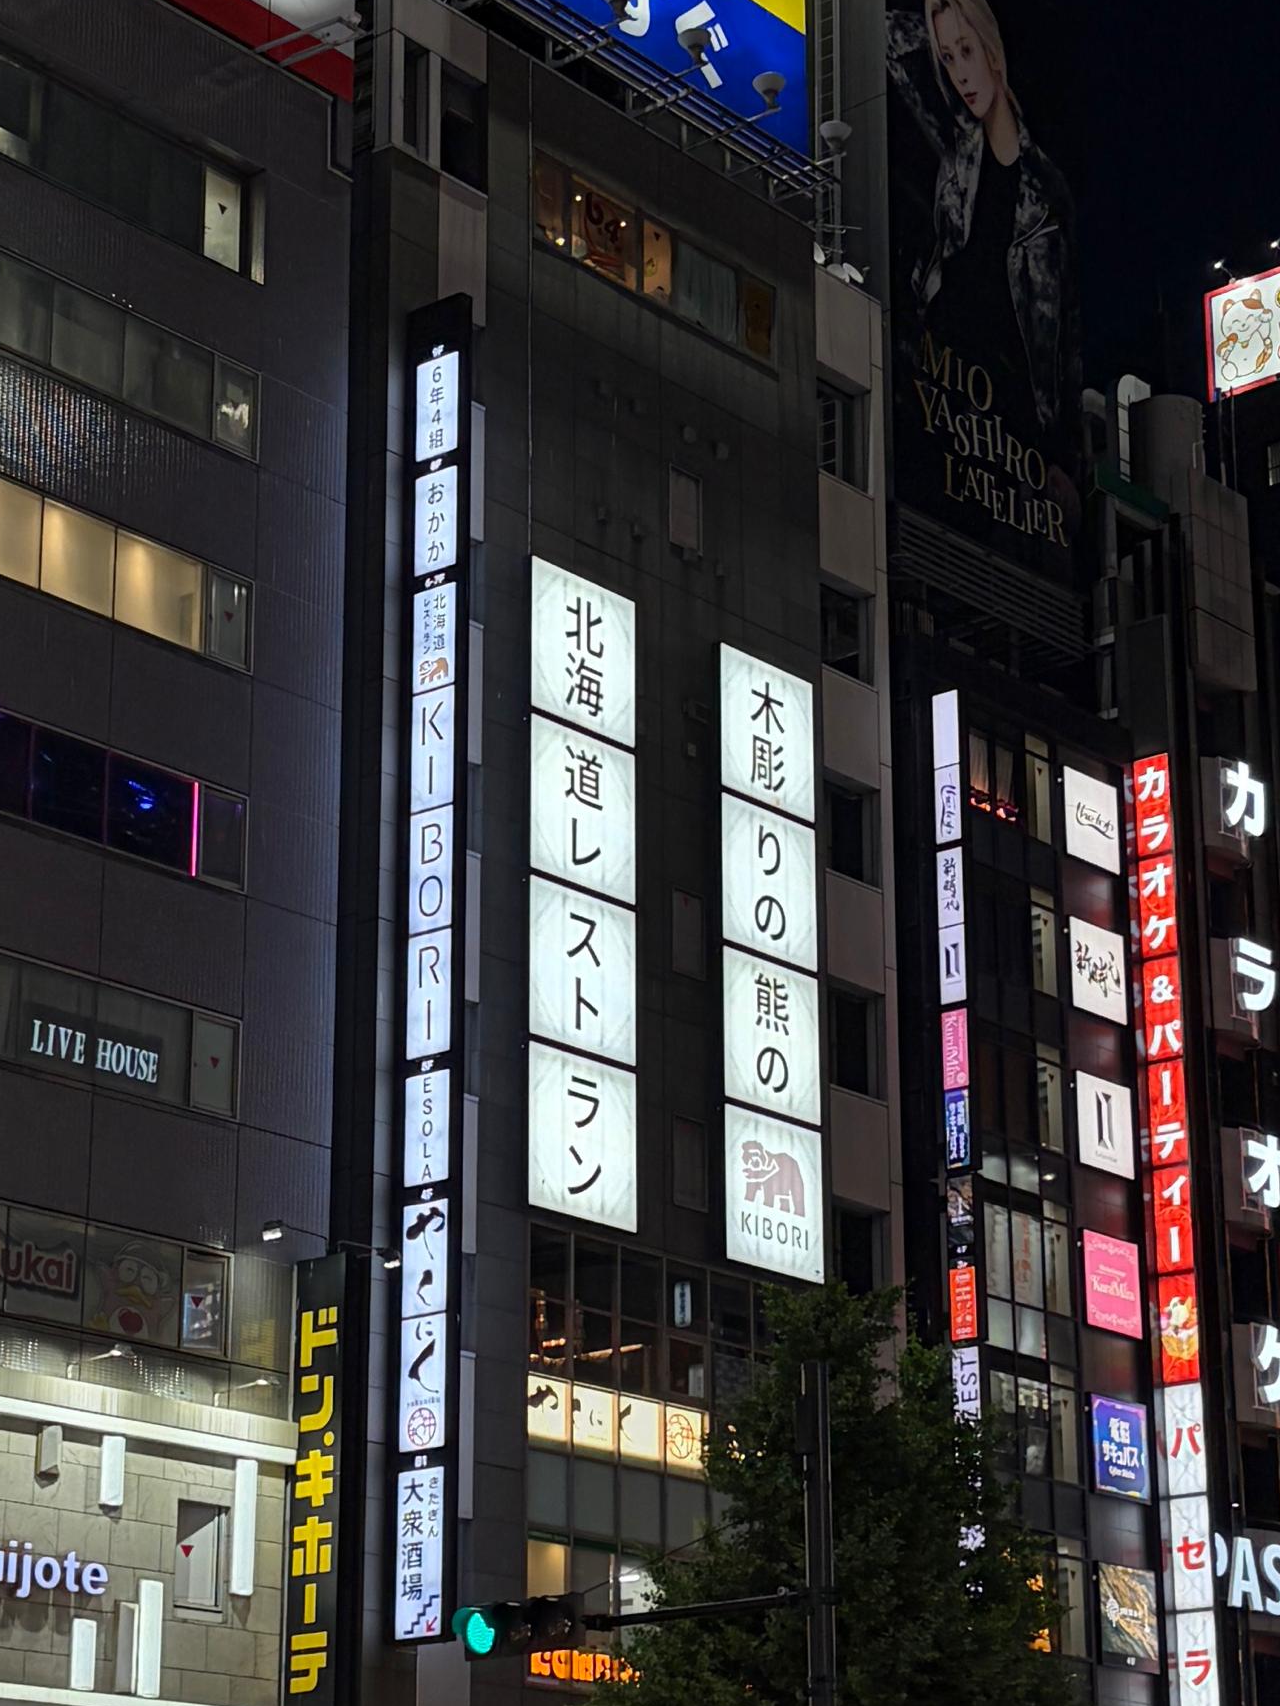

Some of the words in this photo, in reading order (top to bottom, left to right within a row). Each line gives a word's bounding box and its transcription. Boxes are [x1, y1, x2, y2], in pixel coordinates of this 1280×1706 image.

[428, 365, 446, 450] 6年4組
[922, 330, 993, 412] MIO
[914, 380, 1046, 491] YASHIRO
[426, 482, 447, 564] おかか
[432, 593, 447, 652] 北海道
[419, 702, 445, 1041] KIBORI
[563, 596, 605, 1195] 北海道レストラン
[749, 681, 791, 1093] 木彫りの熊の
[30, 1019, 86, 1066] LIVE
[95, 1038, 160, 1084] HOUSE
[421, 1077, 433, 1181] ESOLA
[740, 1211, 810, 1251] KIBORI
[401, 1476, 425, 1603] 大衆酒場
[1170, 1424, 1212, 1687] パセラ
